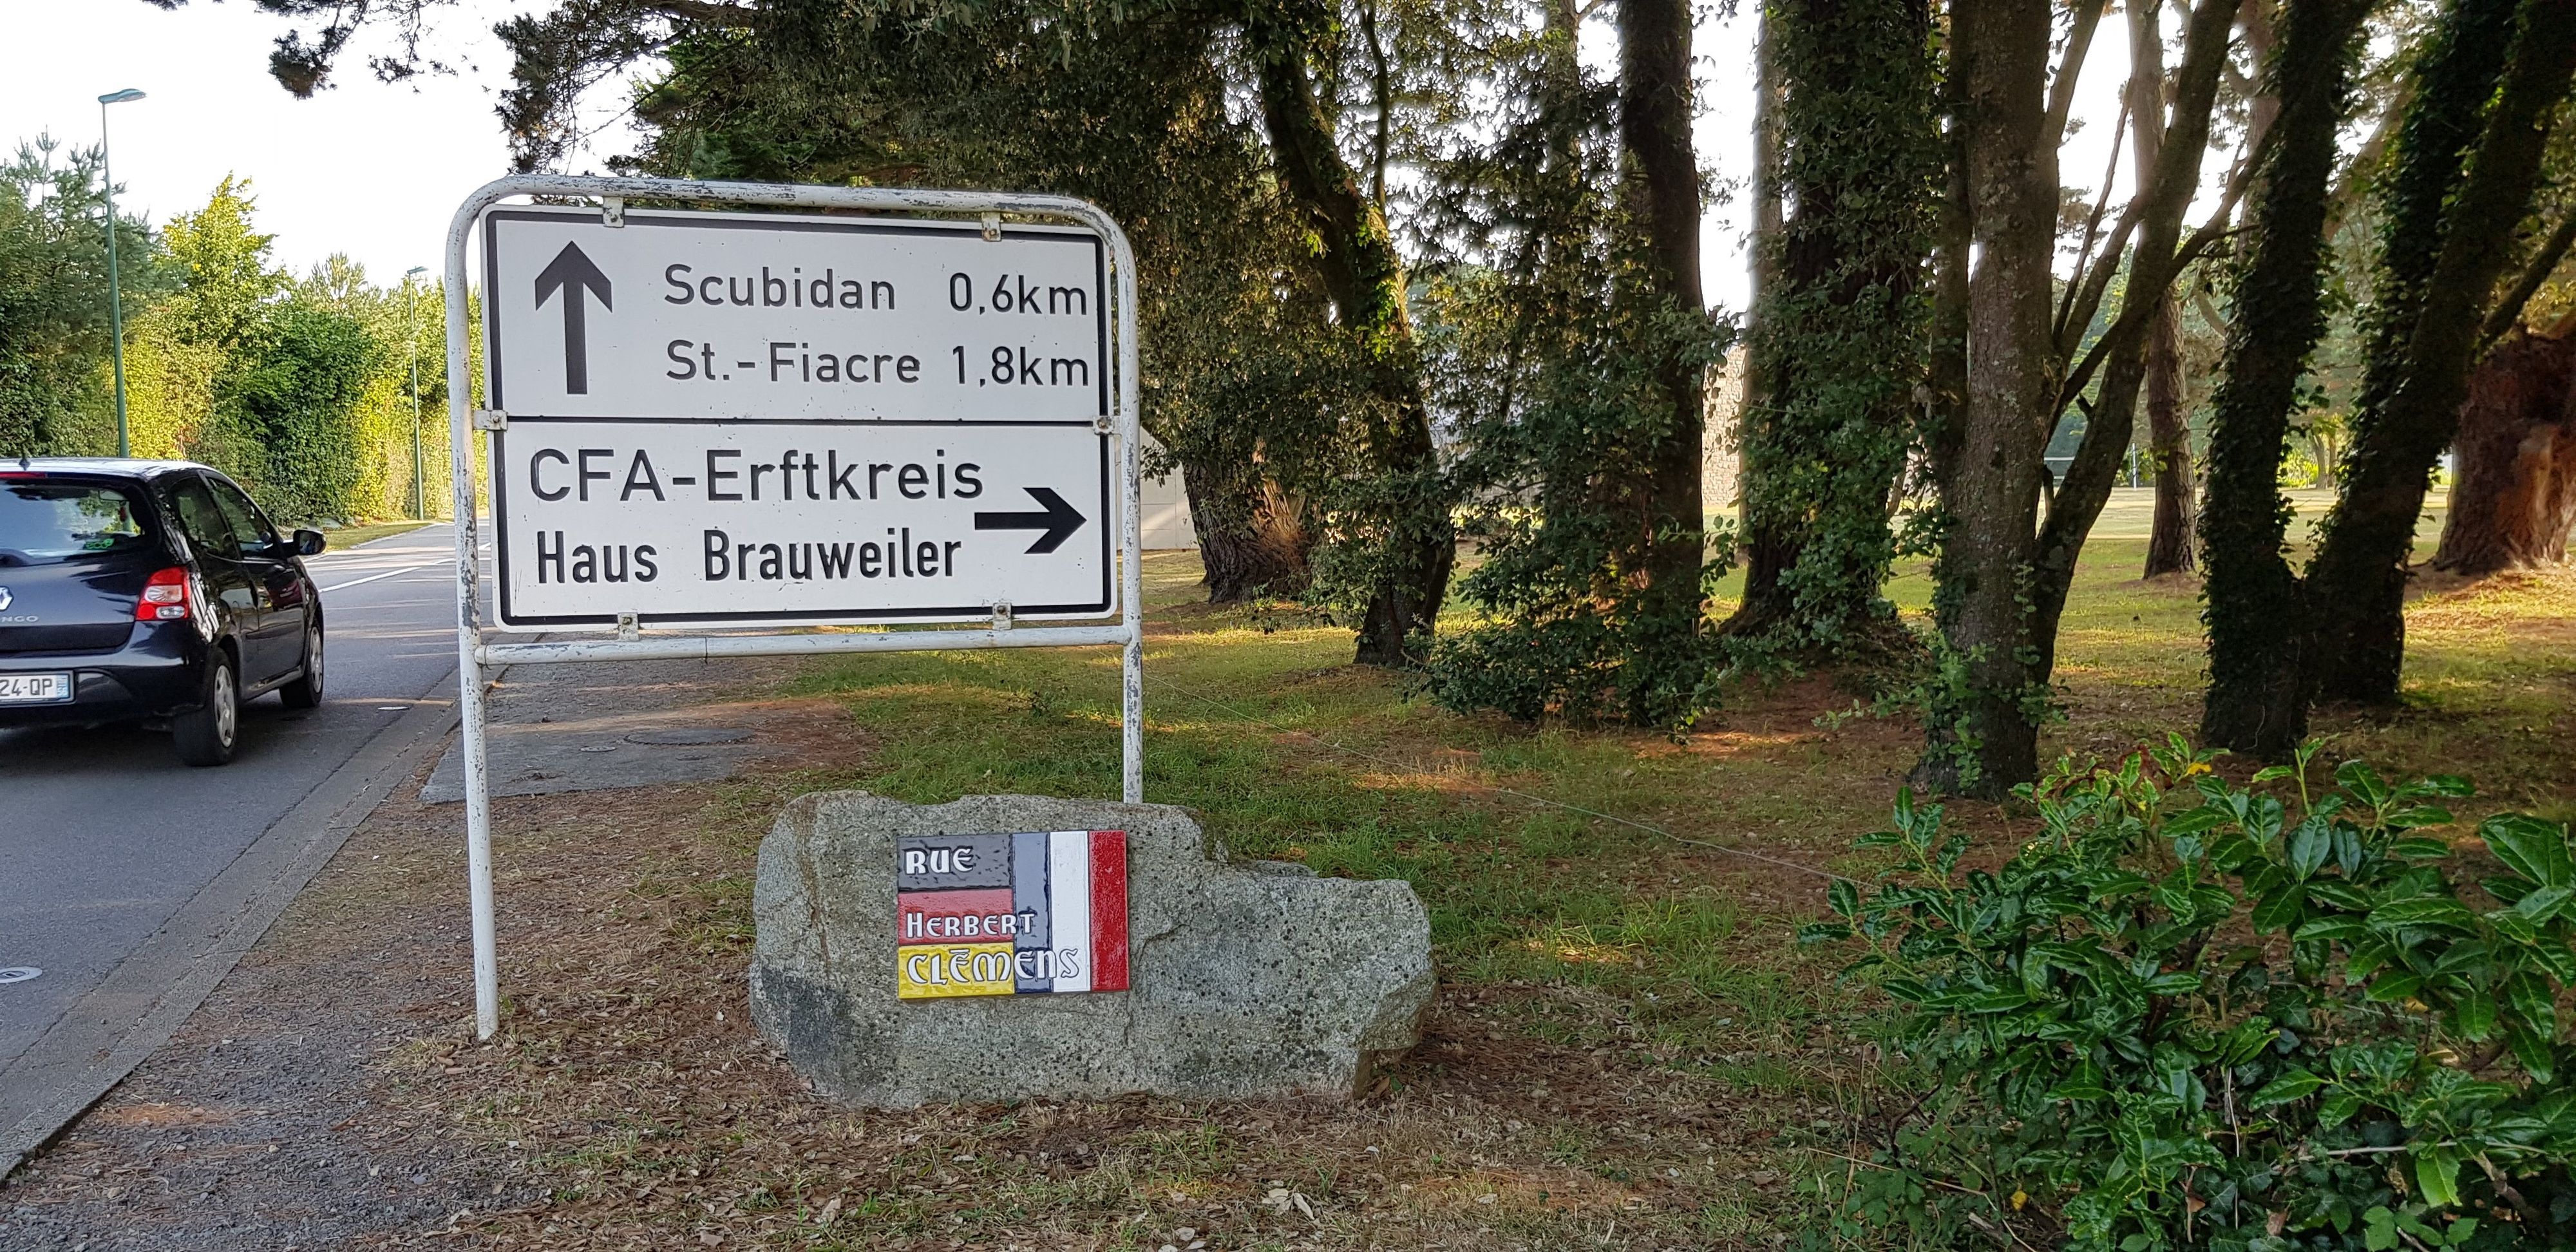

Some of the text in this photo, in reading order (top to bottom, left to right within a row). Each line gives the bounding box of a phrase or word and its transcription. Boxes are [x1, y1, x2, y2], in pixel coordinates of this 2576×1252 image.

[663, 263, 1087, 316] Scubidan 0,6km
[952, 345, 1089, 388] 1,8km
[529, 448, 983, 502] CFA-Erftkreis
[536, 527, 962, 584] Haus Brauweiler
[905, 847, 974, 875] RUE
